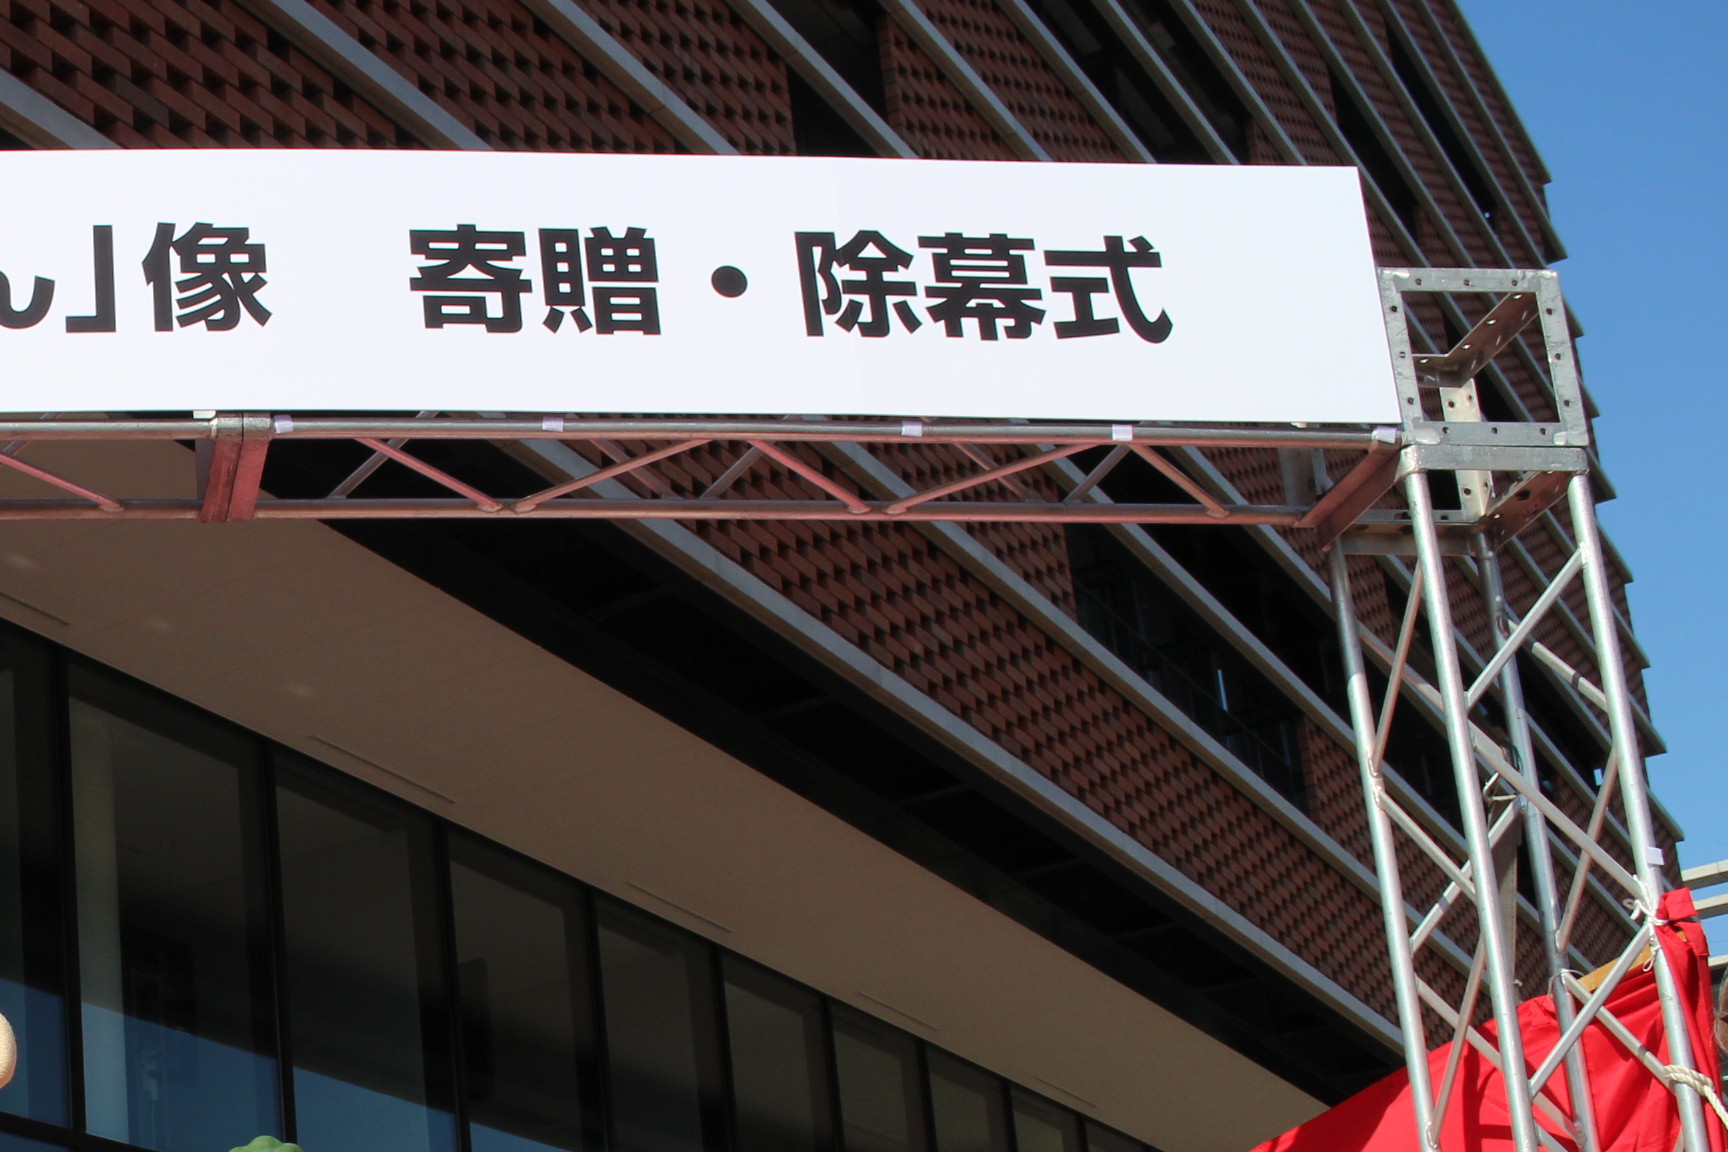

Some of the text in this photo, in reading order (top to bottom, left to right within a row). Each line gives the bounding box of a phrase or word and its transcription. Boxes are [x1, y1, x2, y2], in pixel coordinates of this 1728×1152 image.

[408, 223, 1174, 344] 寄贈・除幕式
